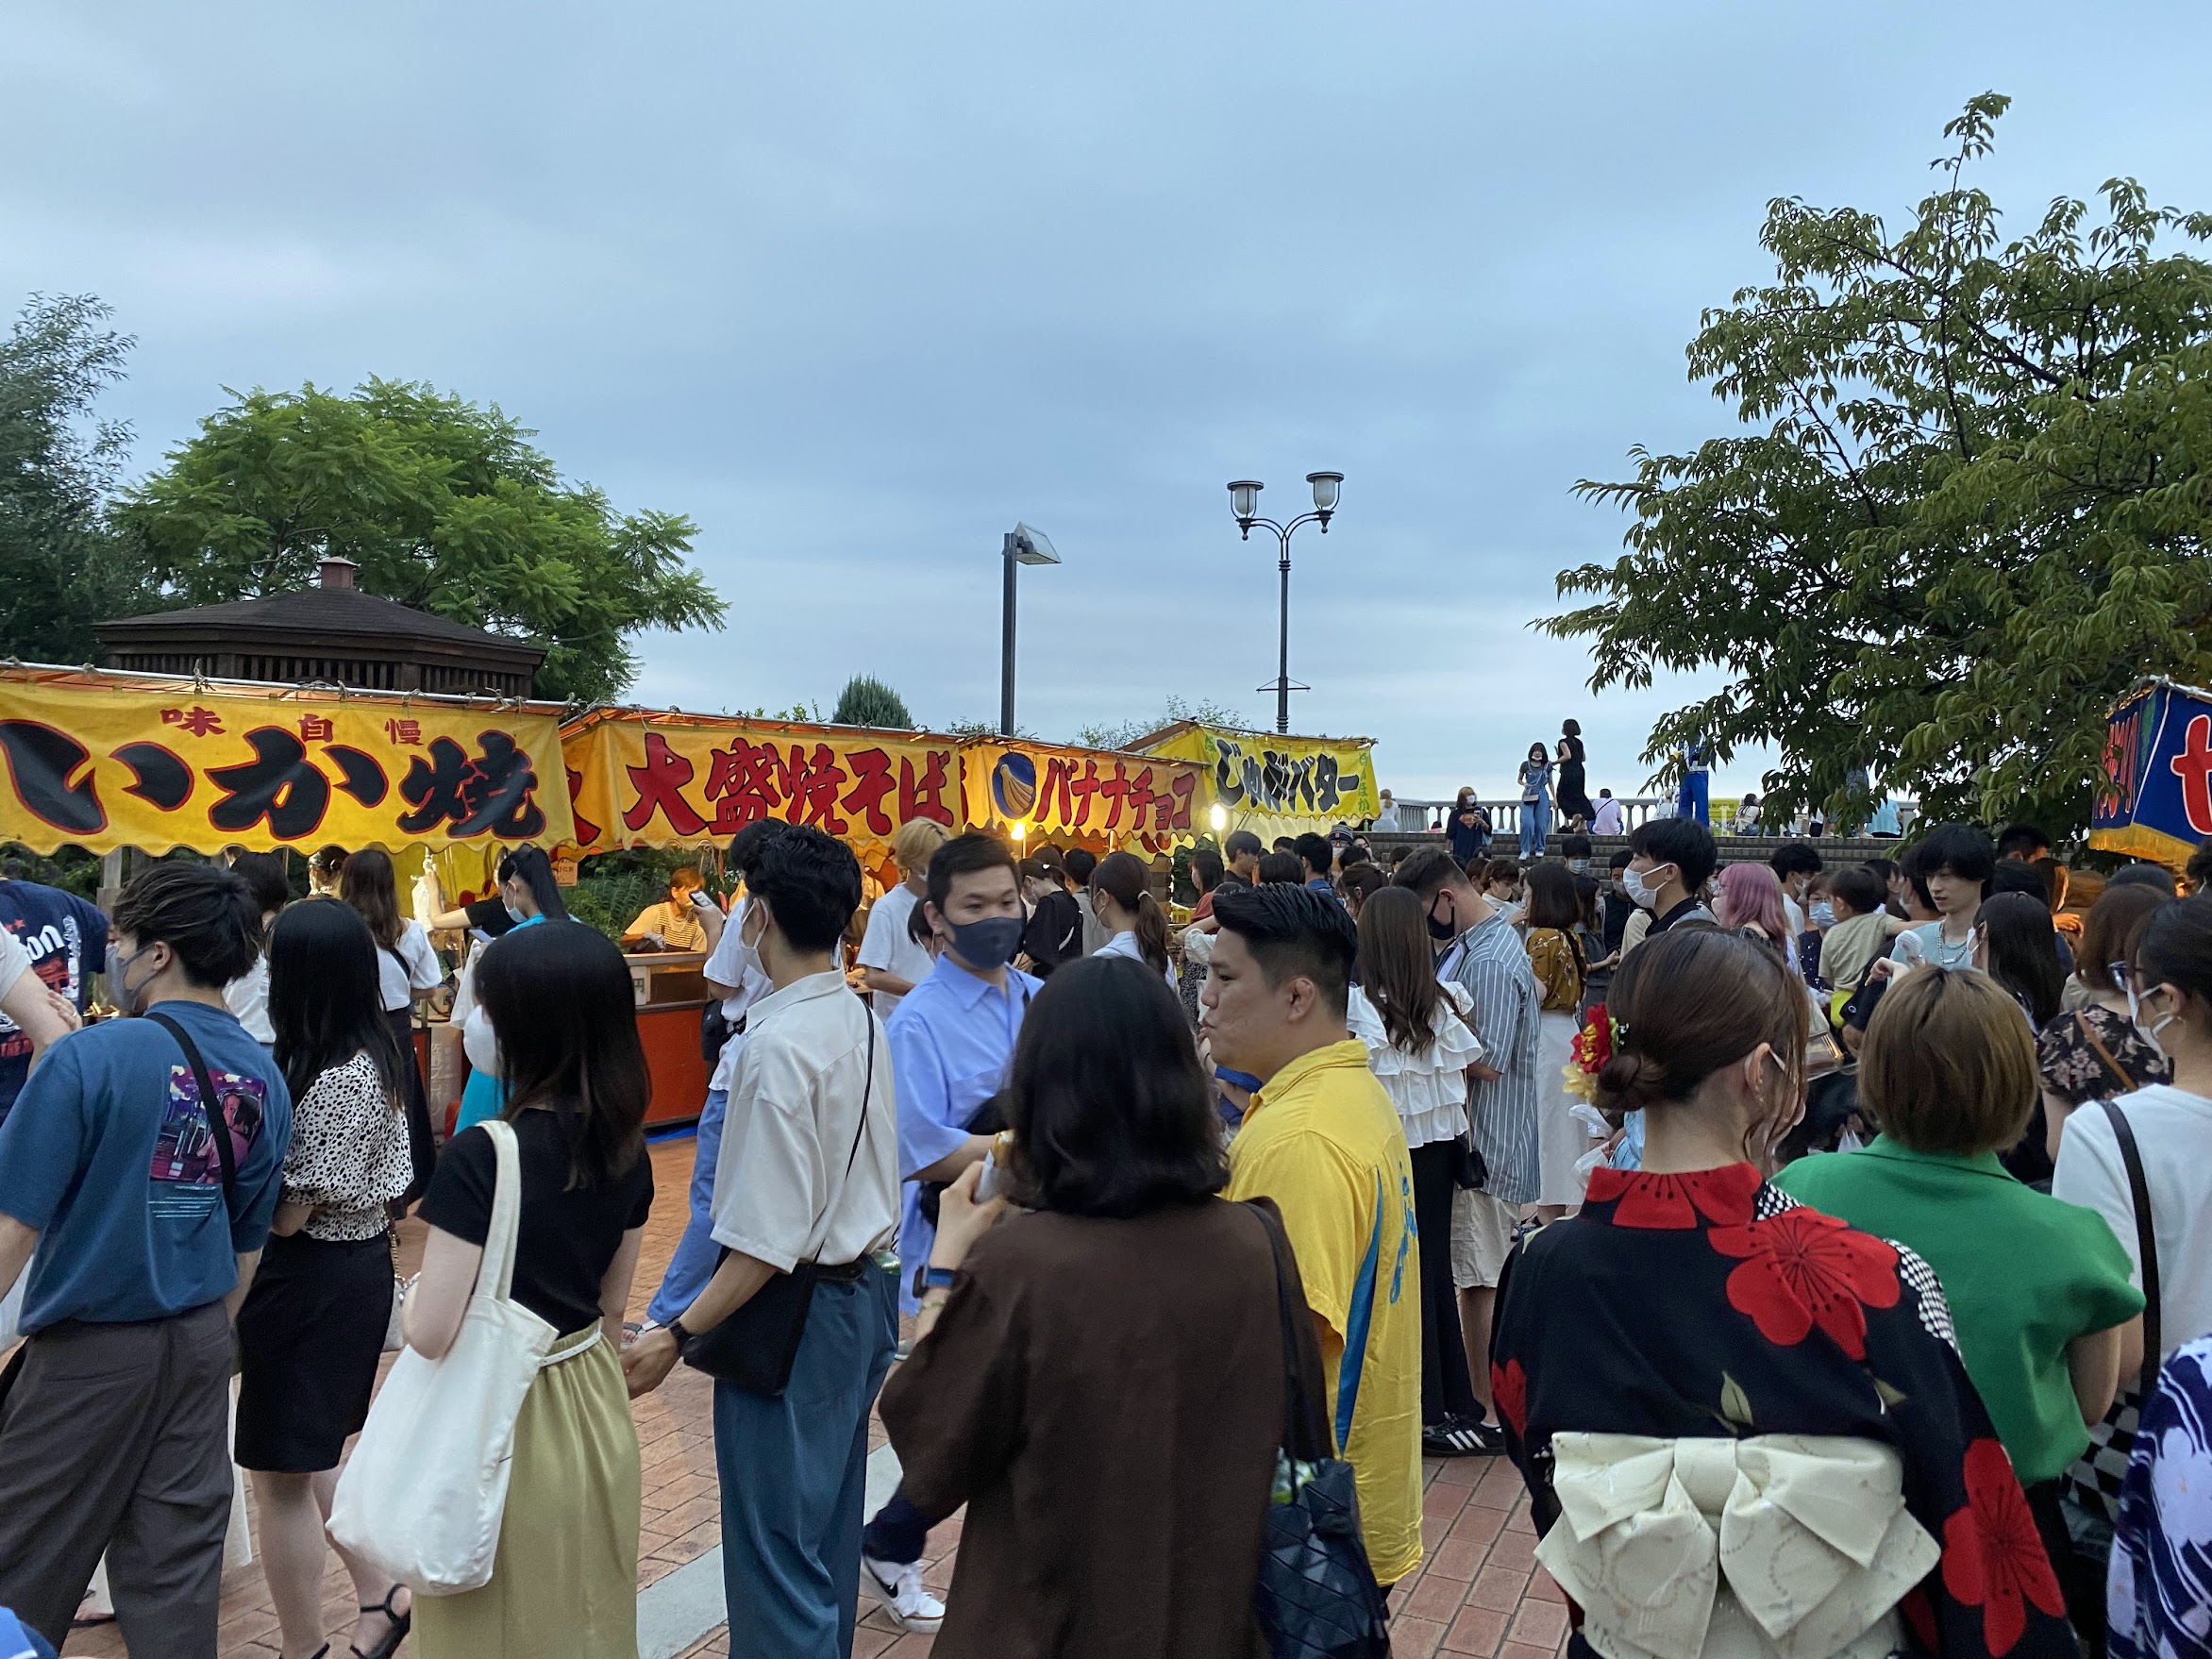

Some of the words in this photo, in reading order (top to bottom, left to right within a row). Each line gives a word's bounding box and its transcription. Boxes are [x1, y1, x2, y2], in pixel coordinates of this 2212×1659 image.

[159, 708, 423, 746] 味自慢
[0, 718, 546, 841] いか焼
[623, 732, 954, 836] 大盛焼そば
[1032, 758, 1196, 830] バナナチョコ
